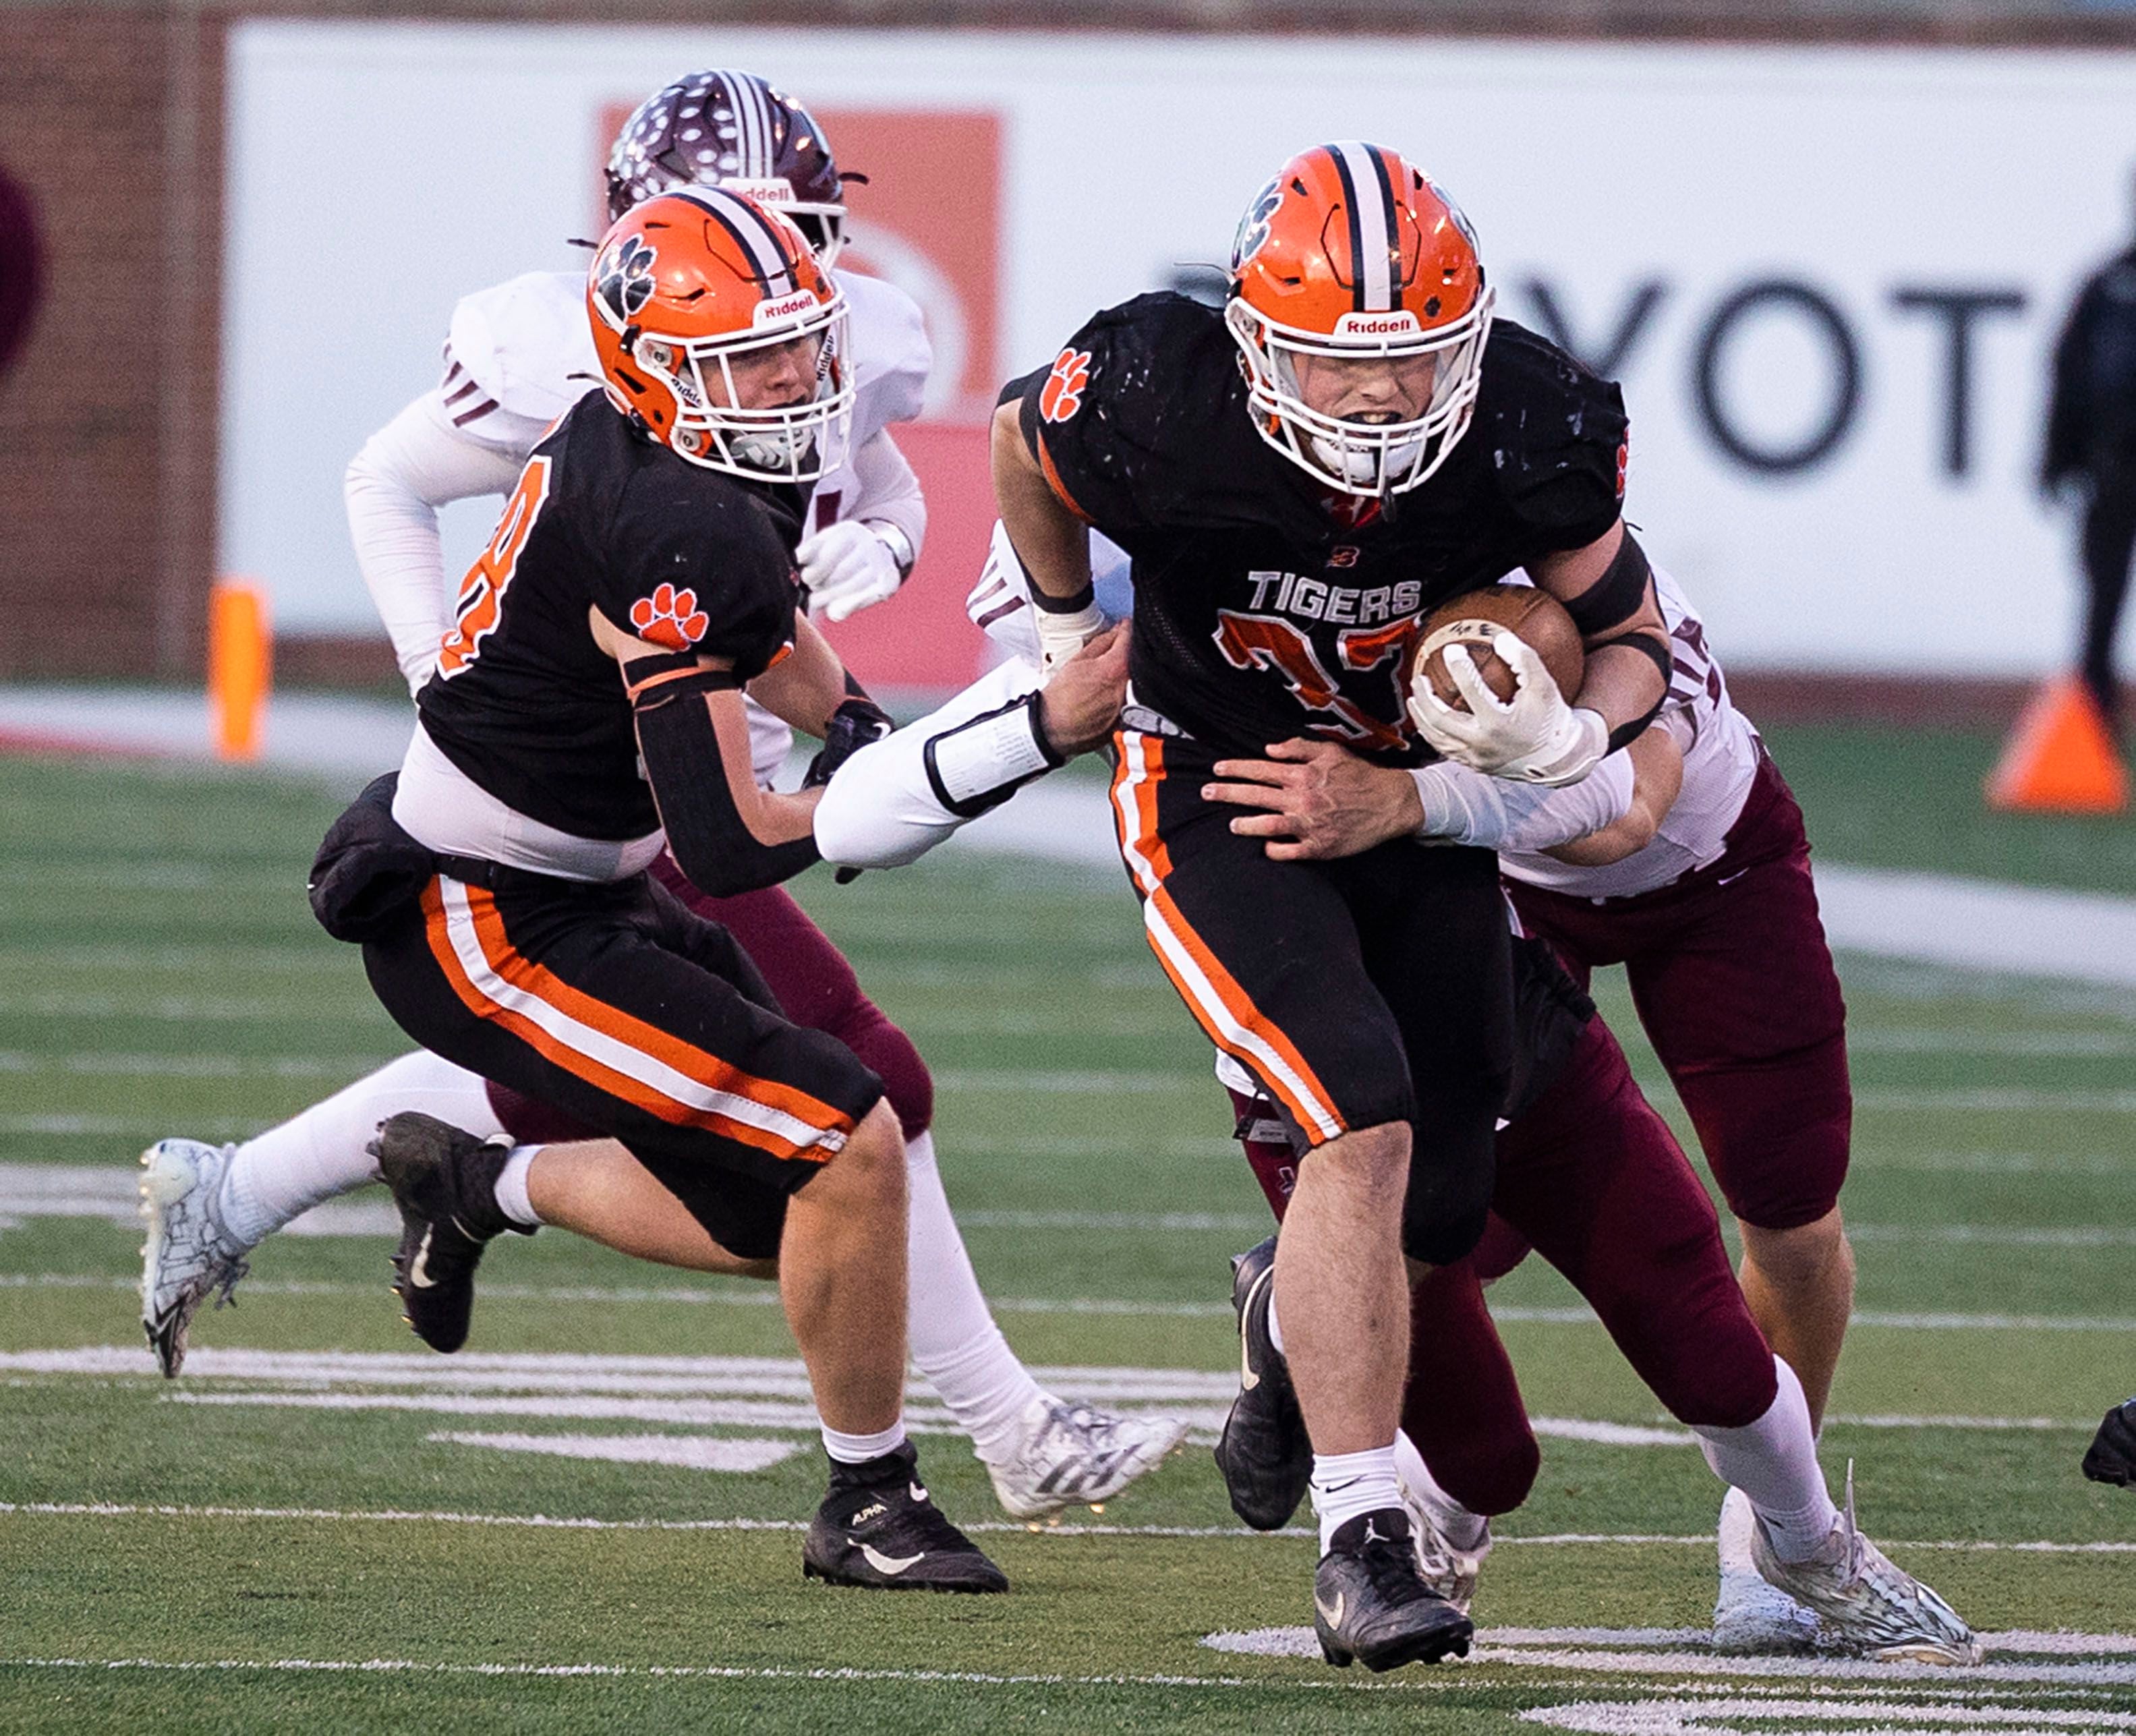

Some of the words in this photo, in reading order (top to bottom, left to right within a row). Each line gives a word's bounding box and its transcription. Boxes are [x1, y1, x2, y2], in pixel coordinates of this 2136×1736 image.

[745, 187, 789, 201] ddell
[764, 295, 814, 318] Riddell
[1347, 319, 1411, 333] Riddell
[1247, 570, 1422, 625] TIGERS
[852, 1503, 888, 1526] ALPHA
